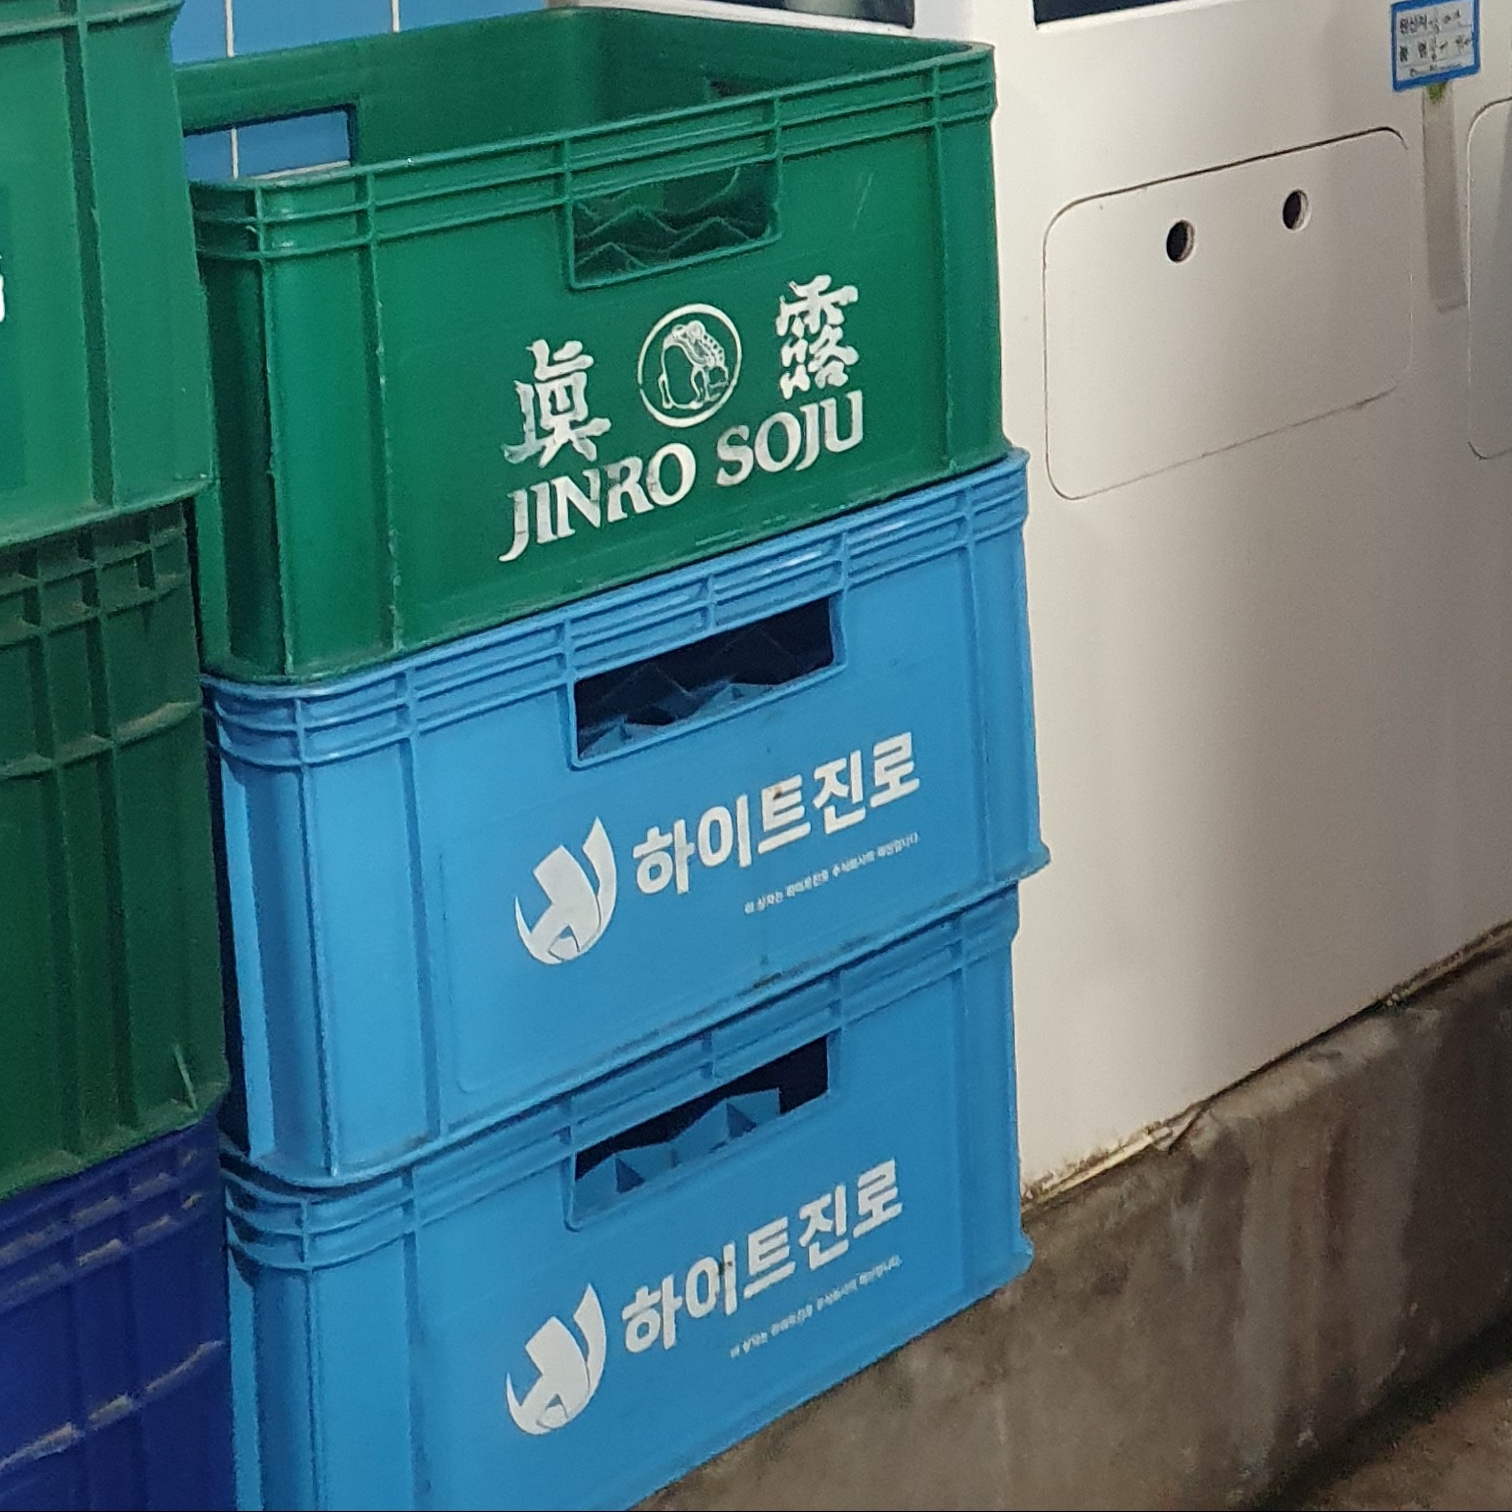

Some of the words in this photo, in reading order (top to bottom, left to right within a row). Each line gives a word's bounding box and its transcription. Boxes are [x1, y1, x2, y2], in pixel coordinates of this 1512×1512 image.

[499, 443, 697, 563] JINRO
[716, 390, 864, 487] SOJU
[632, 731, 920, 895] 하이트진로
[621, 1157, 903, 1355] 하이트진로
